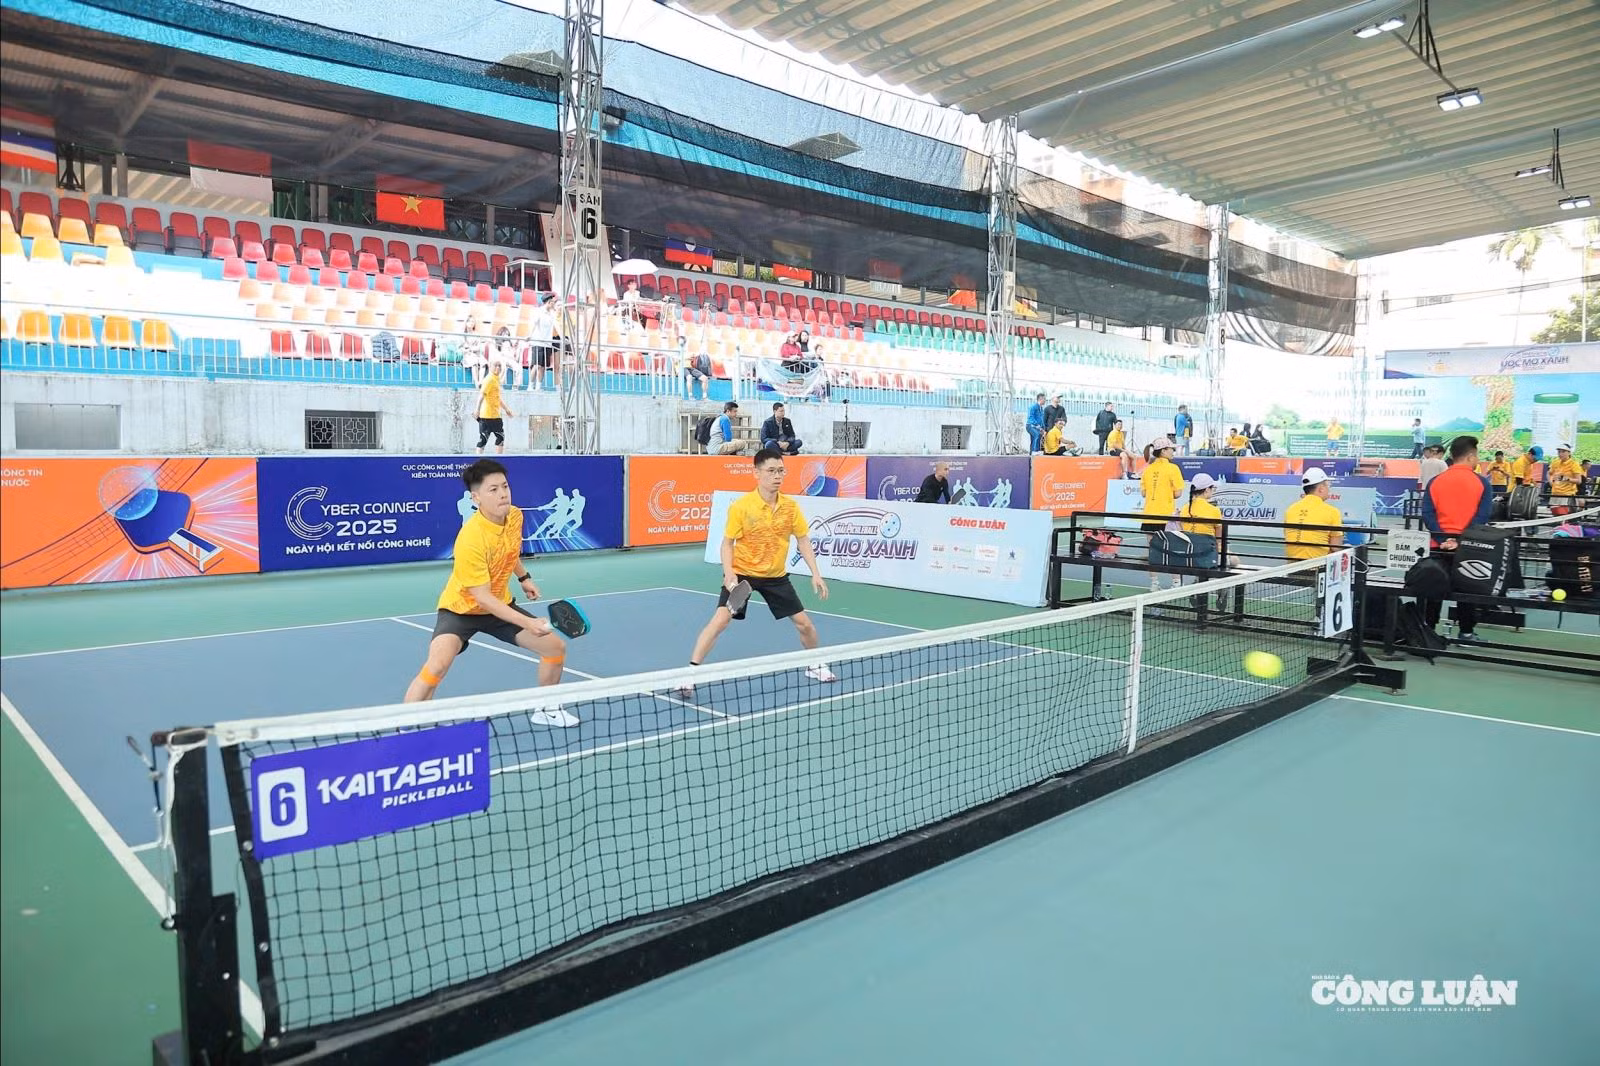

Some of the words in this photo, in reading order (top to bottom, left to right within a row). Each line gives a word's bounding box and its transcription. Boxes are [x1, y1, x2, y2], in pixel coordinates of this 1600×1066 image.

[581, 207, 598, 240] 6
[1220, 328, 1226, 345] 8
[1375, 386, 1426, 399] protein
[28, 469, 43, 477] TIN
[1056, 491, 1076, 501] 2025
[363, 501, 431, 515] CONNECT
[681, 507, 710, 520] 202
[1235, 507, 1276, 519] XANH
[336, 519, 397, 537] 2025
[949, 517, 977, 528] CÔNG
[978, 519, 1006, 530] LUẬN
[286, 543, 314, 555] NGÀY
[316, 542, 335, 554] HỘI
[337, 540, 355, 551] KẾT
[357, 540, 375, 551] NỐI
[377, 538, 404, 549] CÔNG
[405, 536, 432, 548] NGHỆ
[861, 538, 918, 560] XANH
[1460, 540, 1496, 550] SELKIRK
[850, 559, 871, 568] 2025
[1319, 577, 1324, 594] 6
[1333, 592, 1343, 632] 6
[381, 780, 474, 810] PICKLEBALL
[269, 782, 297, 828] 6
